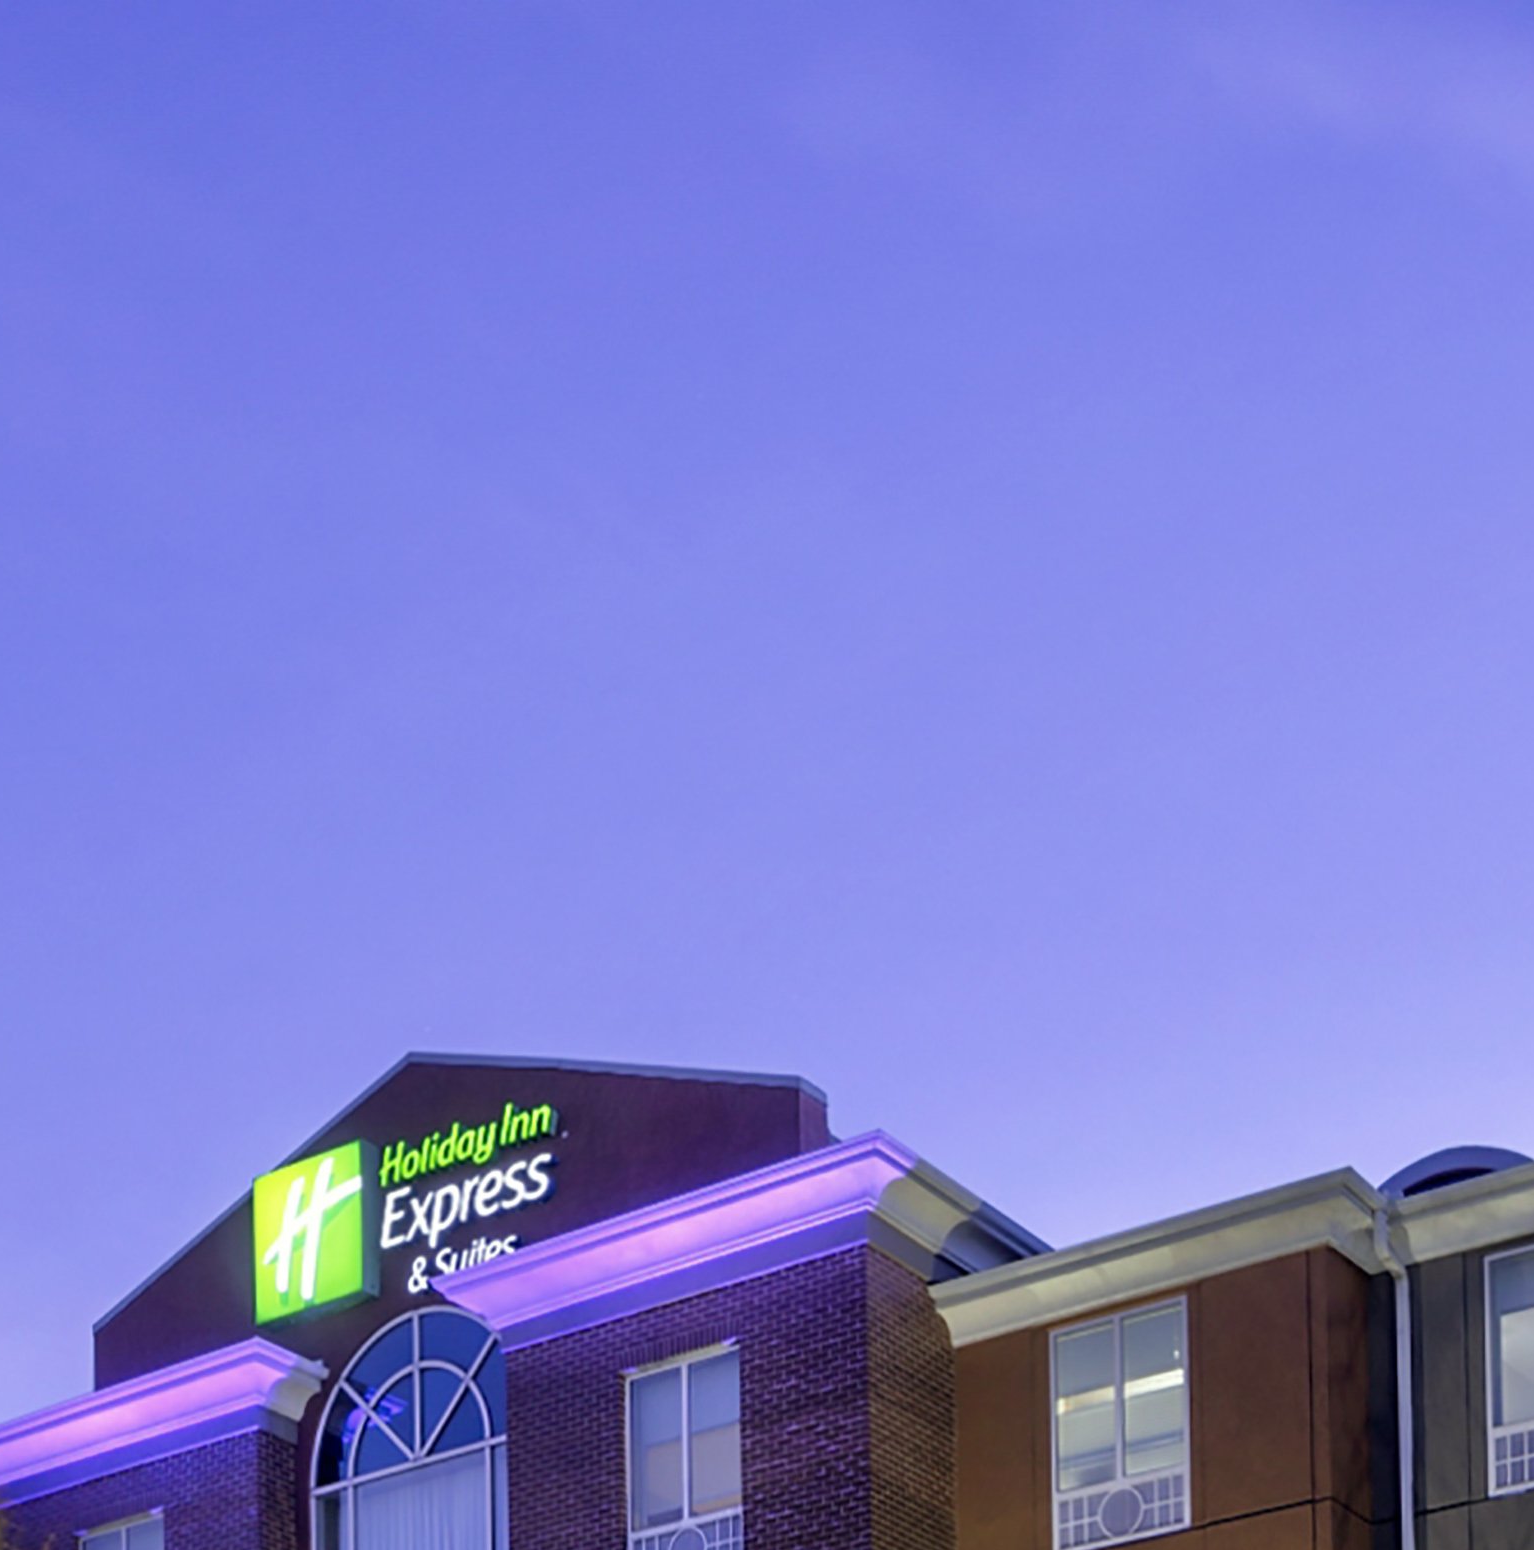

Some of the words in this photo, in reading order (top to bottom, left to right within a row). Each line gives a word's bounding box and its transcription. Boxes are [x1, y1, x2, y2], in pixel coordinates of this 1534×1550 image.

[379, 1122, 498, 1188] Holiday
[499, 1101, 552, 1147] Inn
[379, 1152, 553, 1249] Express
